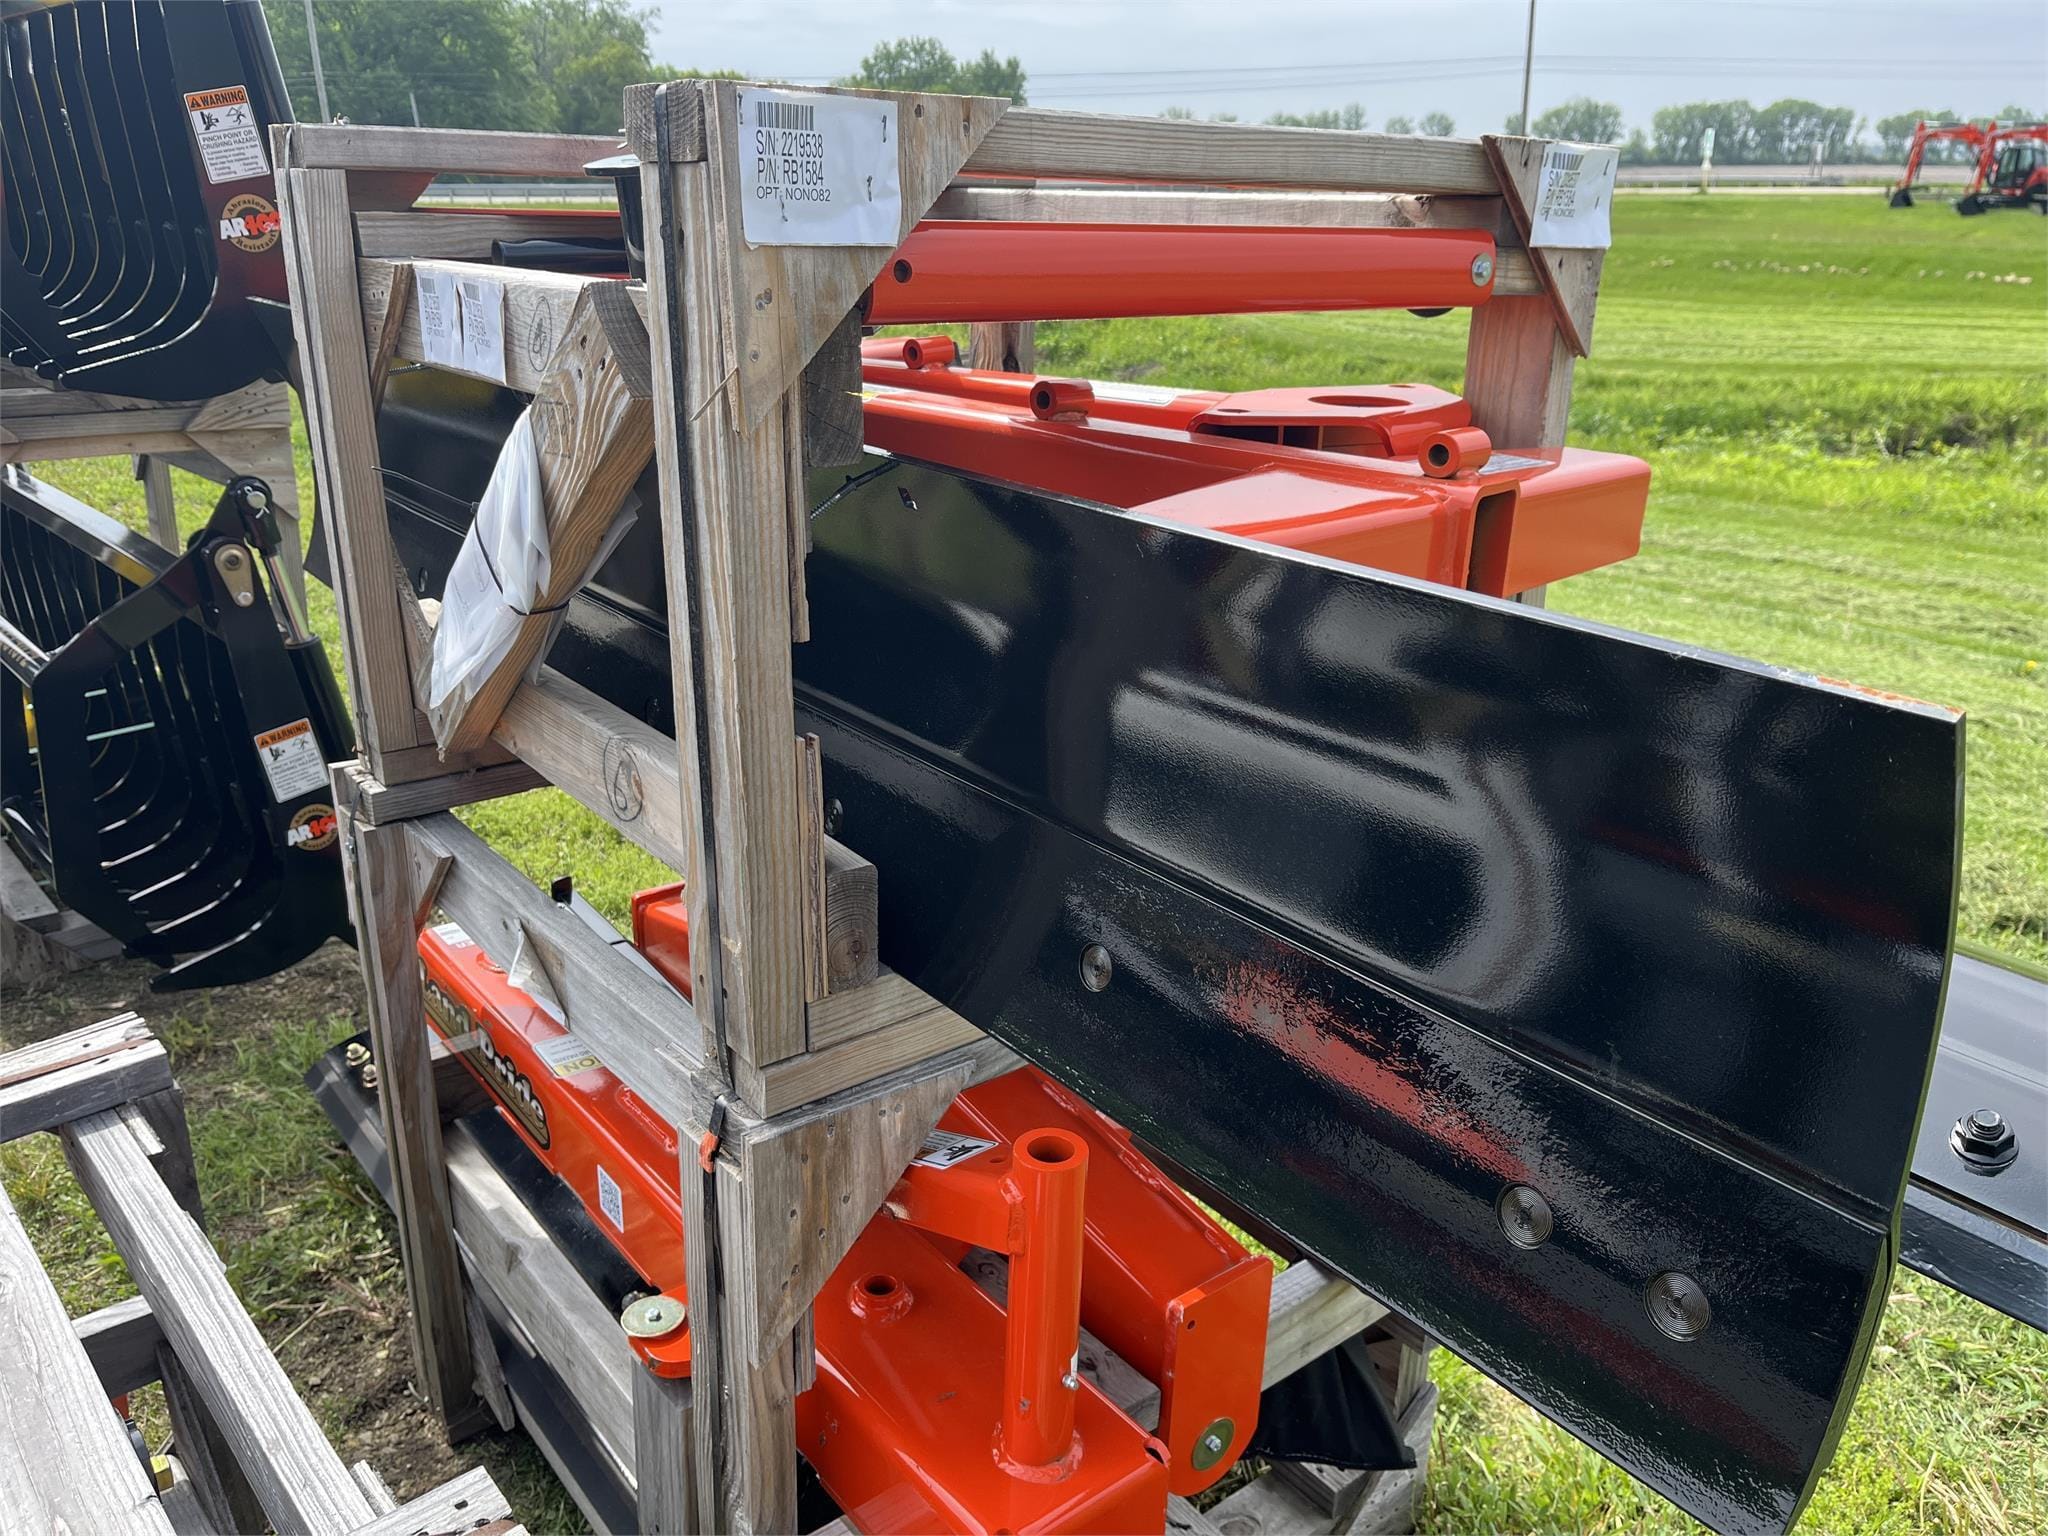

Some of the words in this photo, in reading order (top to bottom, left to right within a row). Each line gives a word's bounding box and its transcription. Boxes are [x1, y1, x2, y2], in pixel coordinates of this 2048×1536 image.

[200, 90, 245, 107] WARNING
[201, 140, 233, 150] CRUSHING
[233, 135, 258, 144] HAZARD
[202, 134, 222, 143] PINCH
[223, 130, 241, 139] POINT
[243, 129, 254, 137] OR
[756, 129, 779, 156] S/N:
[781, 131, 823, 159] 2219538
[757, 157, 780, 184] P/N:
[783, 159, 824, 186] RB1584
[756, 185, 783, 200] OPT:
[271, 722, 308, 741] WARNING
[479, 1028, 544, 1122] Pride
